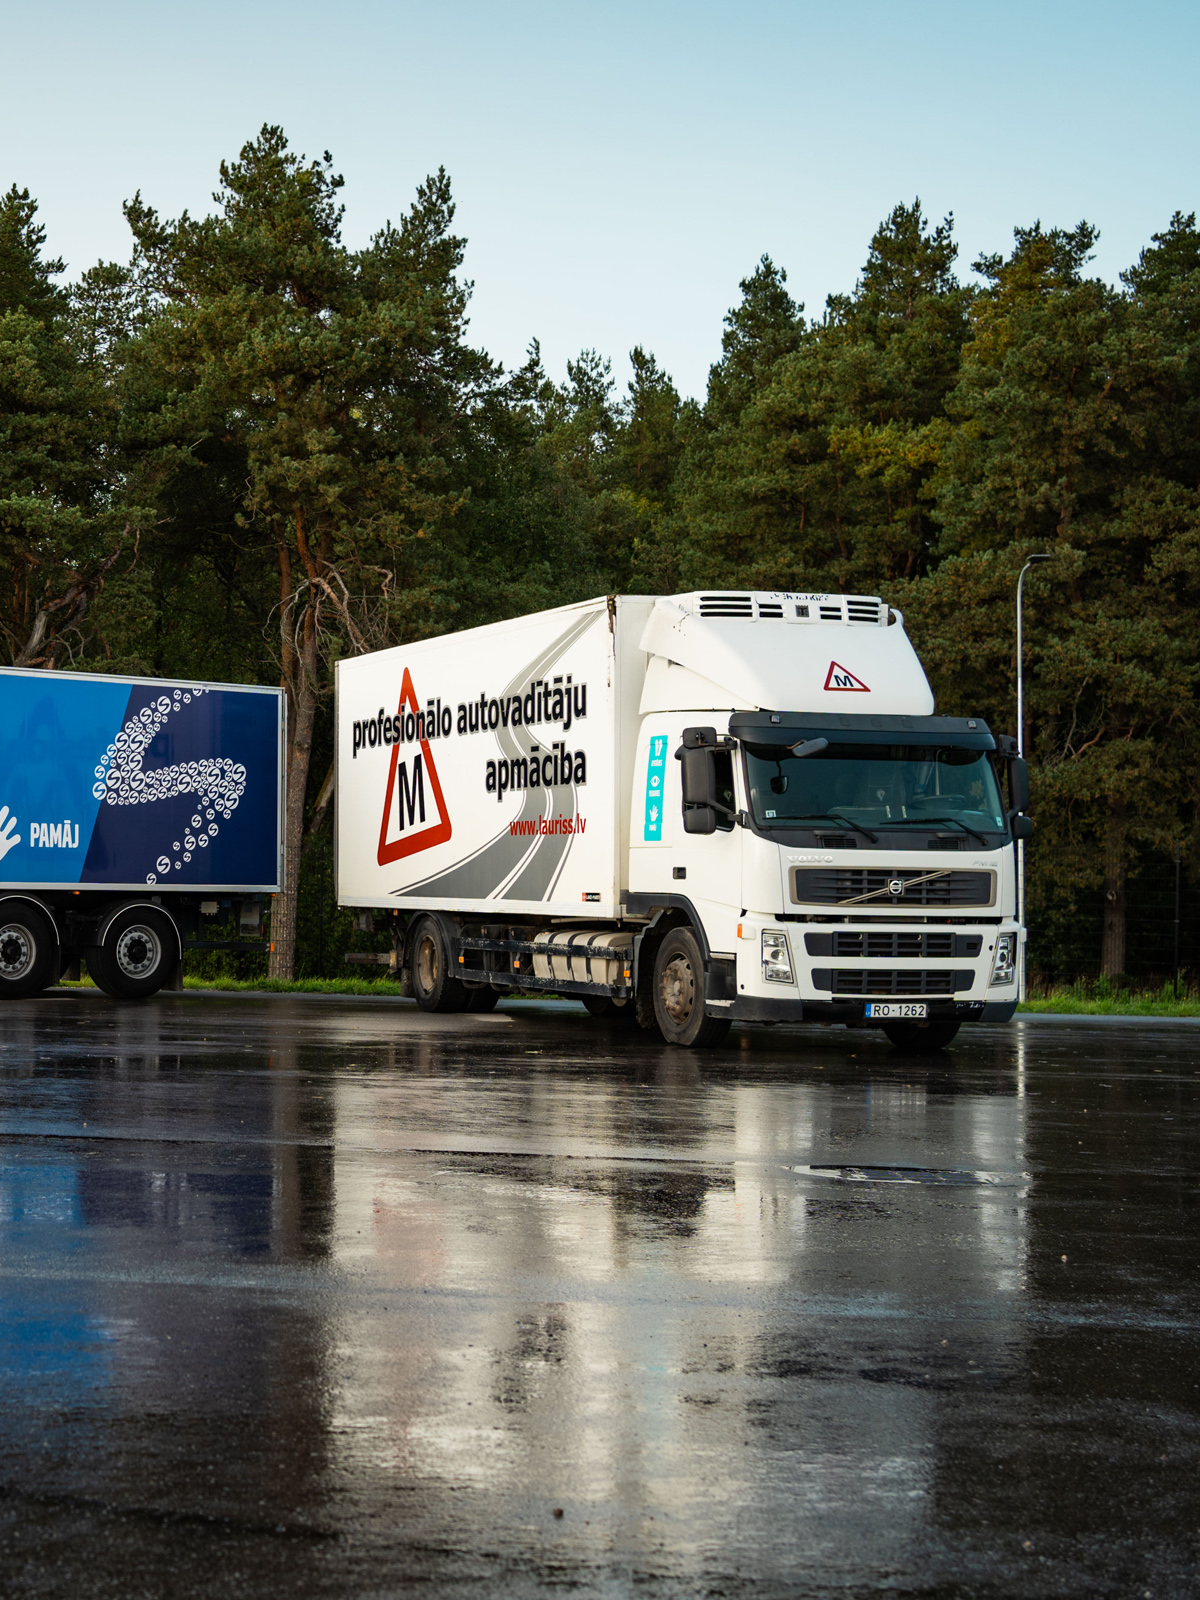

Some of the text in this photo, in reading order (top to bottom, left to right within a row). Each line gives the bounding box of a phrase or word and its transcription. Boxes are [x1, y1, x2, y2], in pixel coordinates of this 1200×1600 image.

[834, 674, 854, 687] M
[353, 673, 588, 759] profesionālo autovadītāju
[486, 740, 587, 803] apmācība
[398, 753, 426, 831] M
[30, 819, 79, 849] PAMĀJ
[509, 813, 587, 836] www.lauriss.lv
[786, 855, 833, 863] VOLVO
